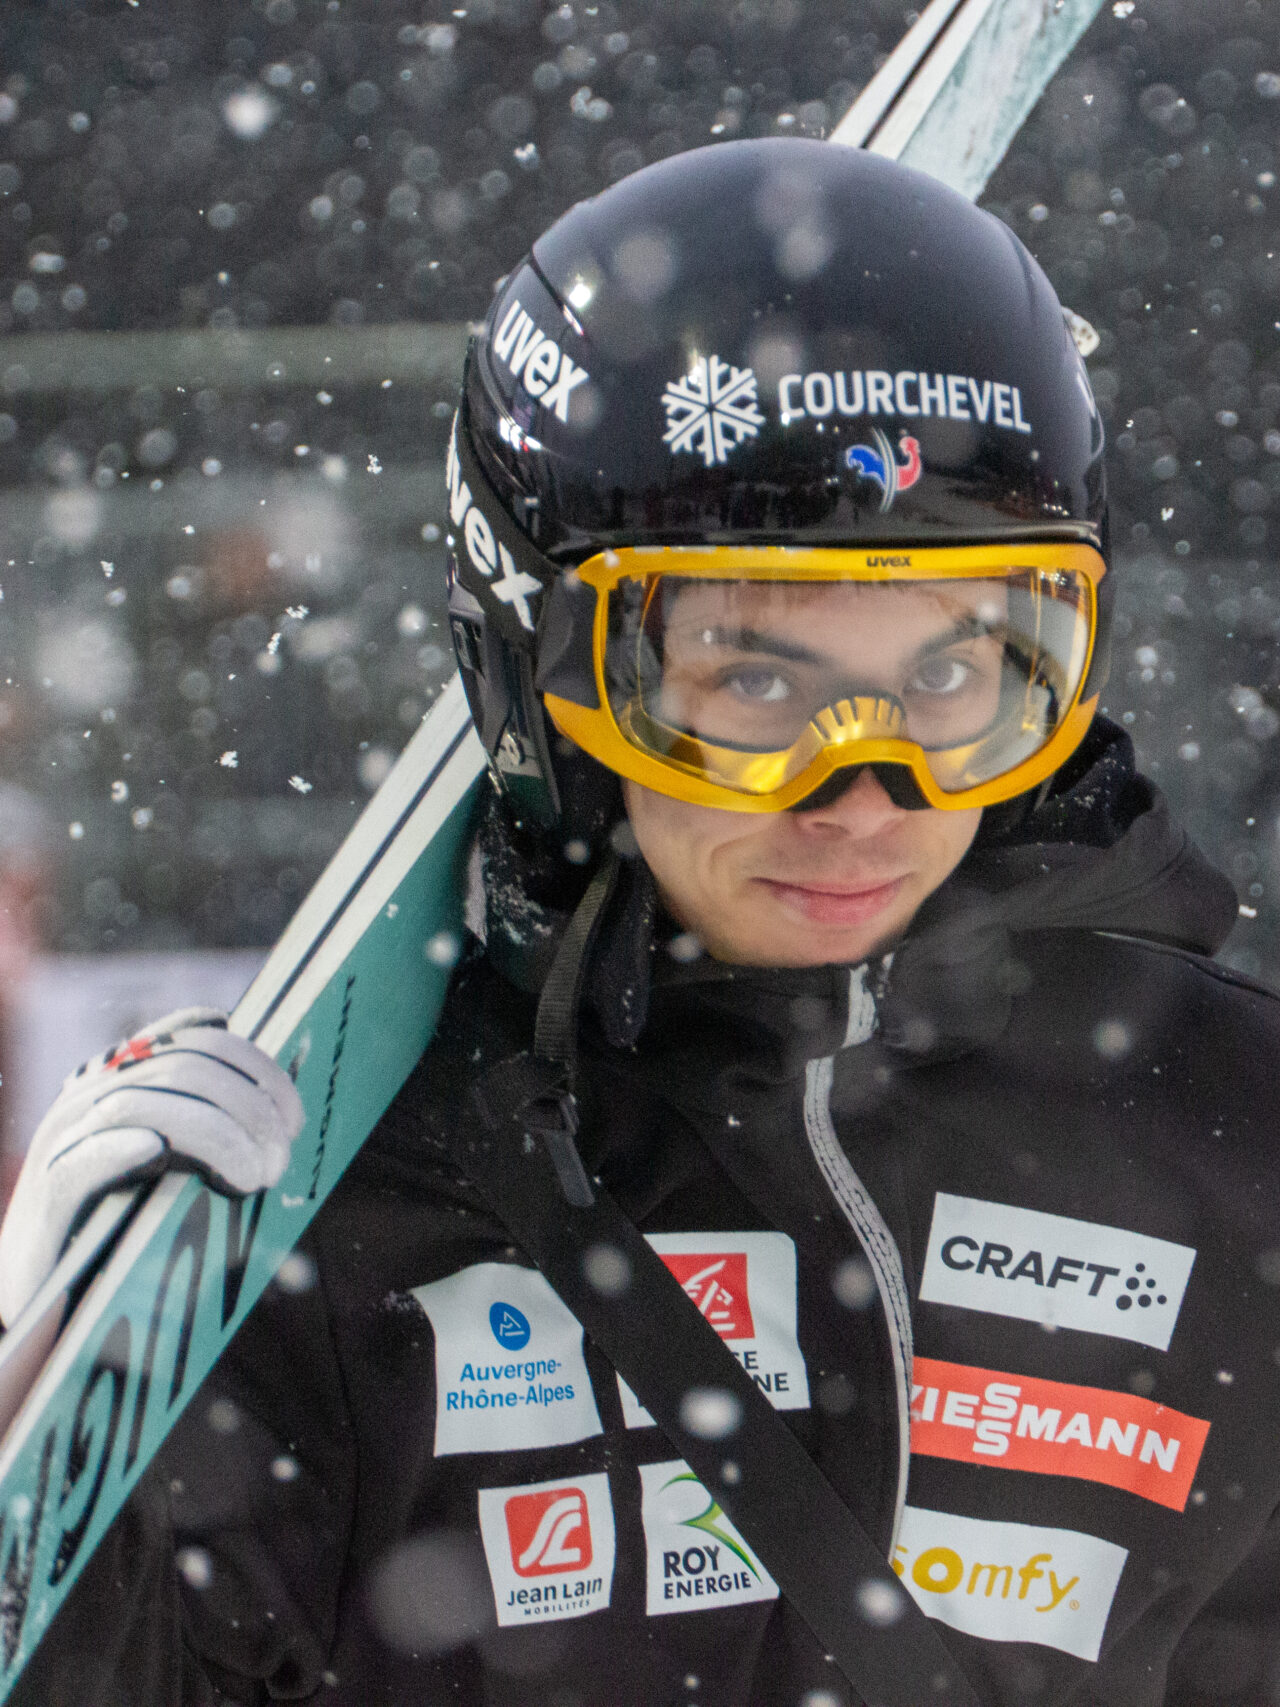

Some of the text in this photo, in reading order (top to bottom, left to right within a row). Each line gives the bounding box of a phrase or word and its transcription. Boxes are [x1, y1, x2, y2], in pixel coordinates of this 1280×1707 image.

[493, 300, 589, 422] uvex
[778, 370, 1032, 433] COURCHEVEL
[866, 553, 912, 569] uvex
[940, 1235, 1120, 1298] CRAFT
[459, 1358, 562, 1383] Auvergne-
[446, 1382, 575, 1412] Rhône-Alpes
[663, 1545, 721, 1578] ROY
[507, 1577, 603, 1607] Jean Lain
[664, 1571, 752, 1600] ENERGIE
